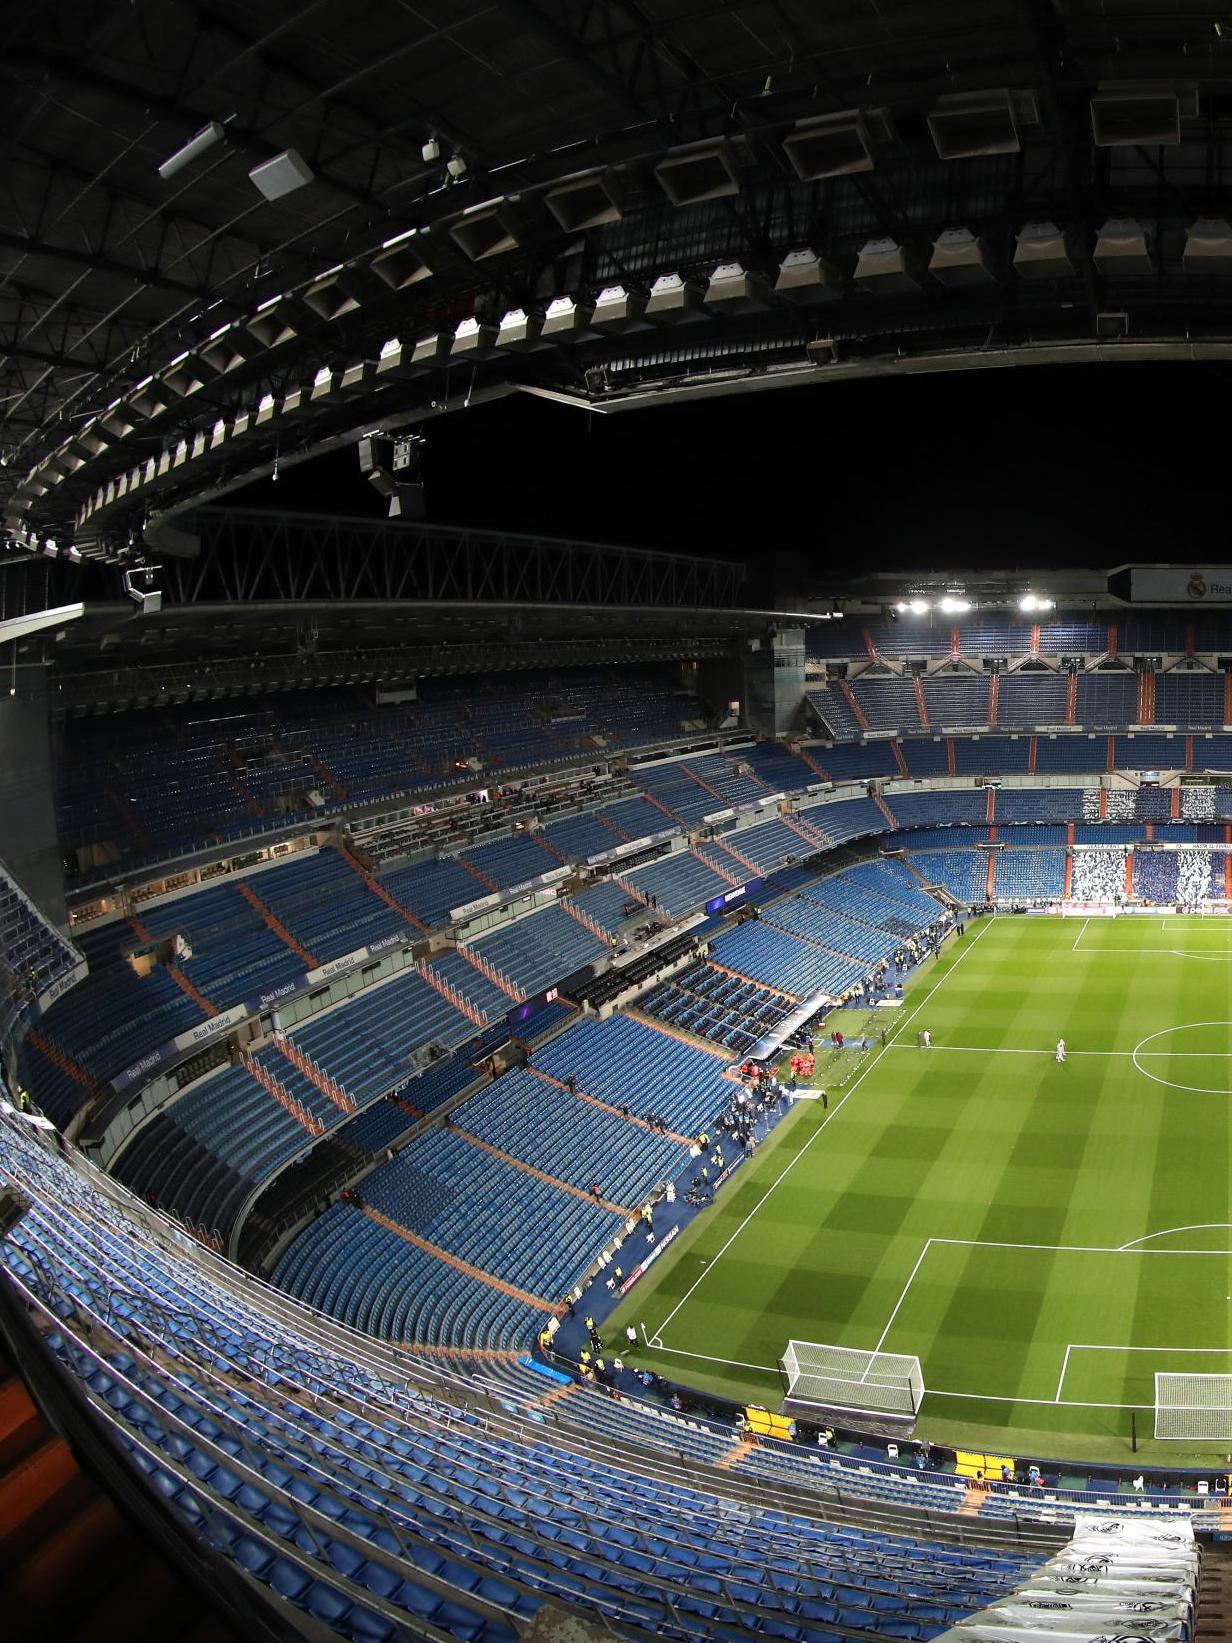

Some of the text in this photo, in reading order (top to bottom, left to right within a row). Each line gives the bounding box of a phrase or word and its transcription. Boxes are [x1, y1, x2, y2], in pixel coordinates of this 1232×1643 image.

[323, 956, 355, 976] Real Madrid
[260, 982, 296, 1004] Real Madrid
[193, 1015, 231, 1040] Real Madrid
